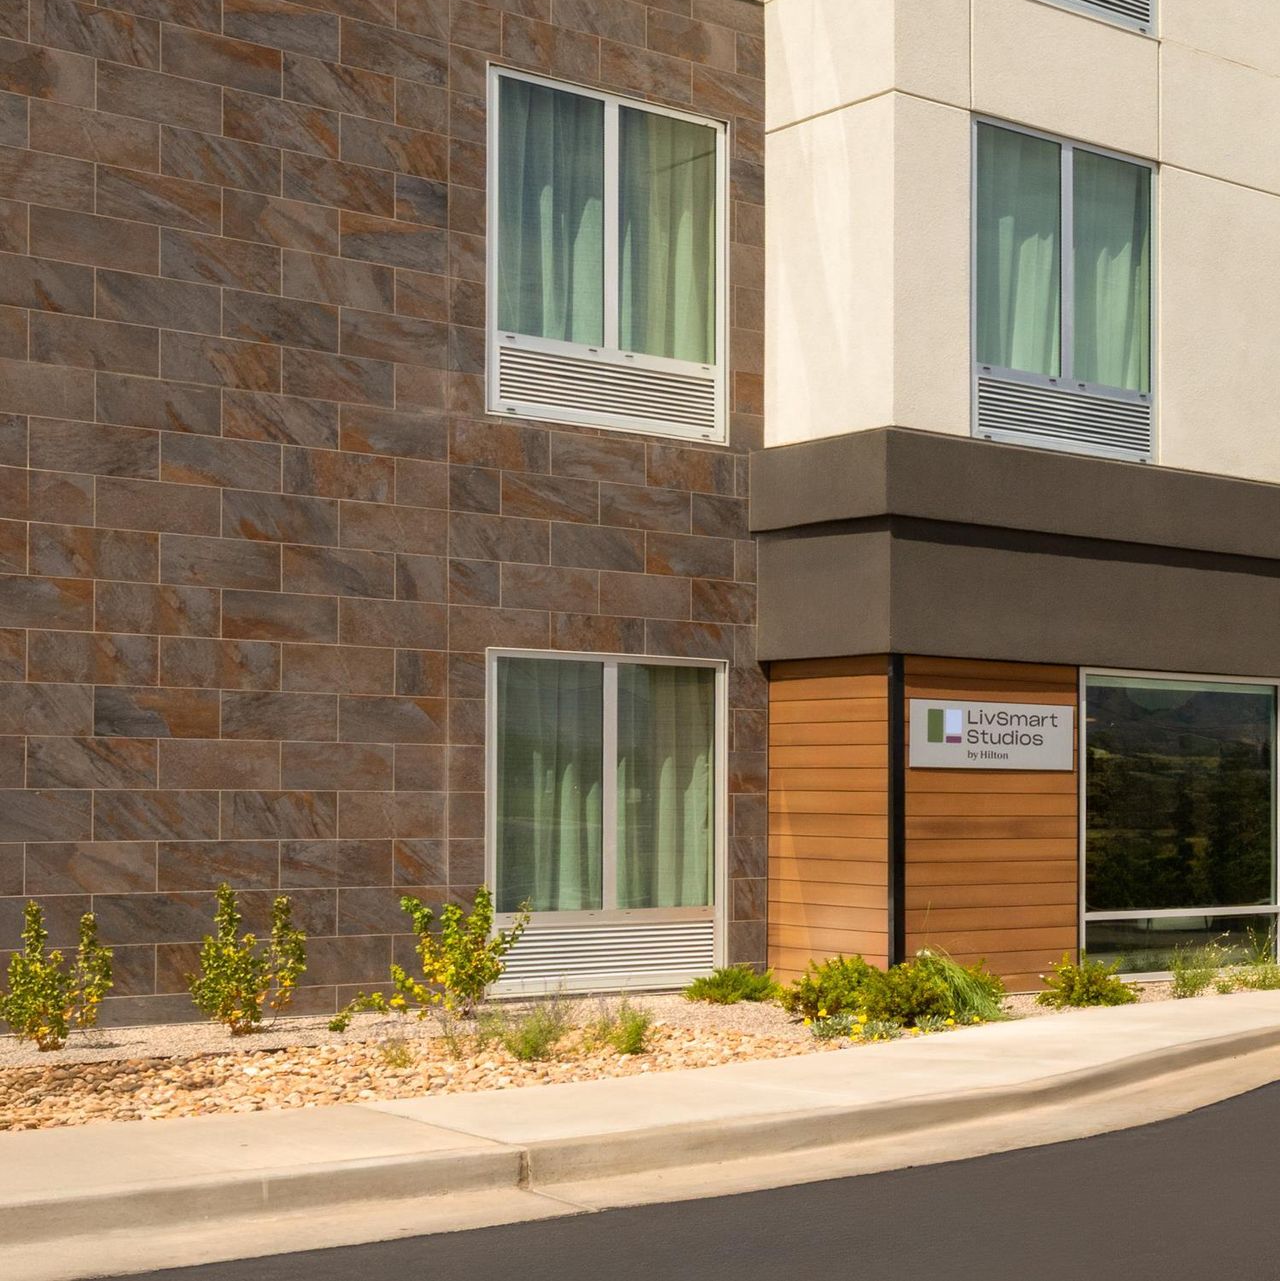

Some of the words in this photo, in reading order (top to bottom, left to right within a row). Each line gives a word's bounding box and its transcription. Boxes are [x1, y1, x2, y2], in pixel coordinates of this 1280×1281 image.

[967, 709, 1058, 728] LivSmart
[967, 729, 1044, 746] Studios
[967, 750, 979, 761] by
[980, 750, 1009, 760] Hilton
